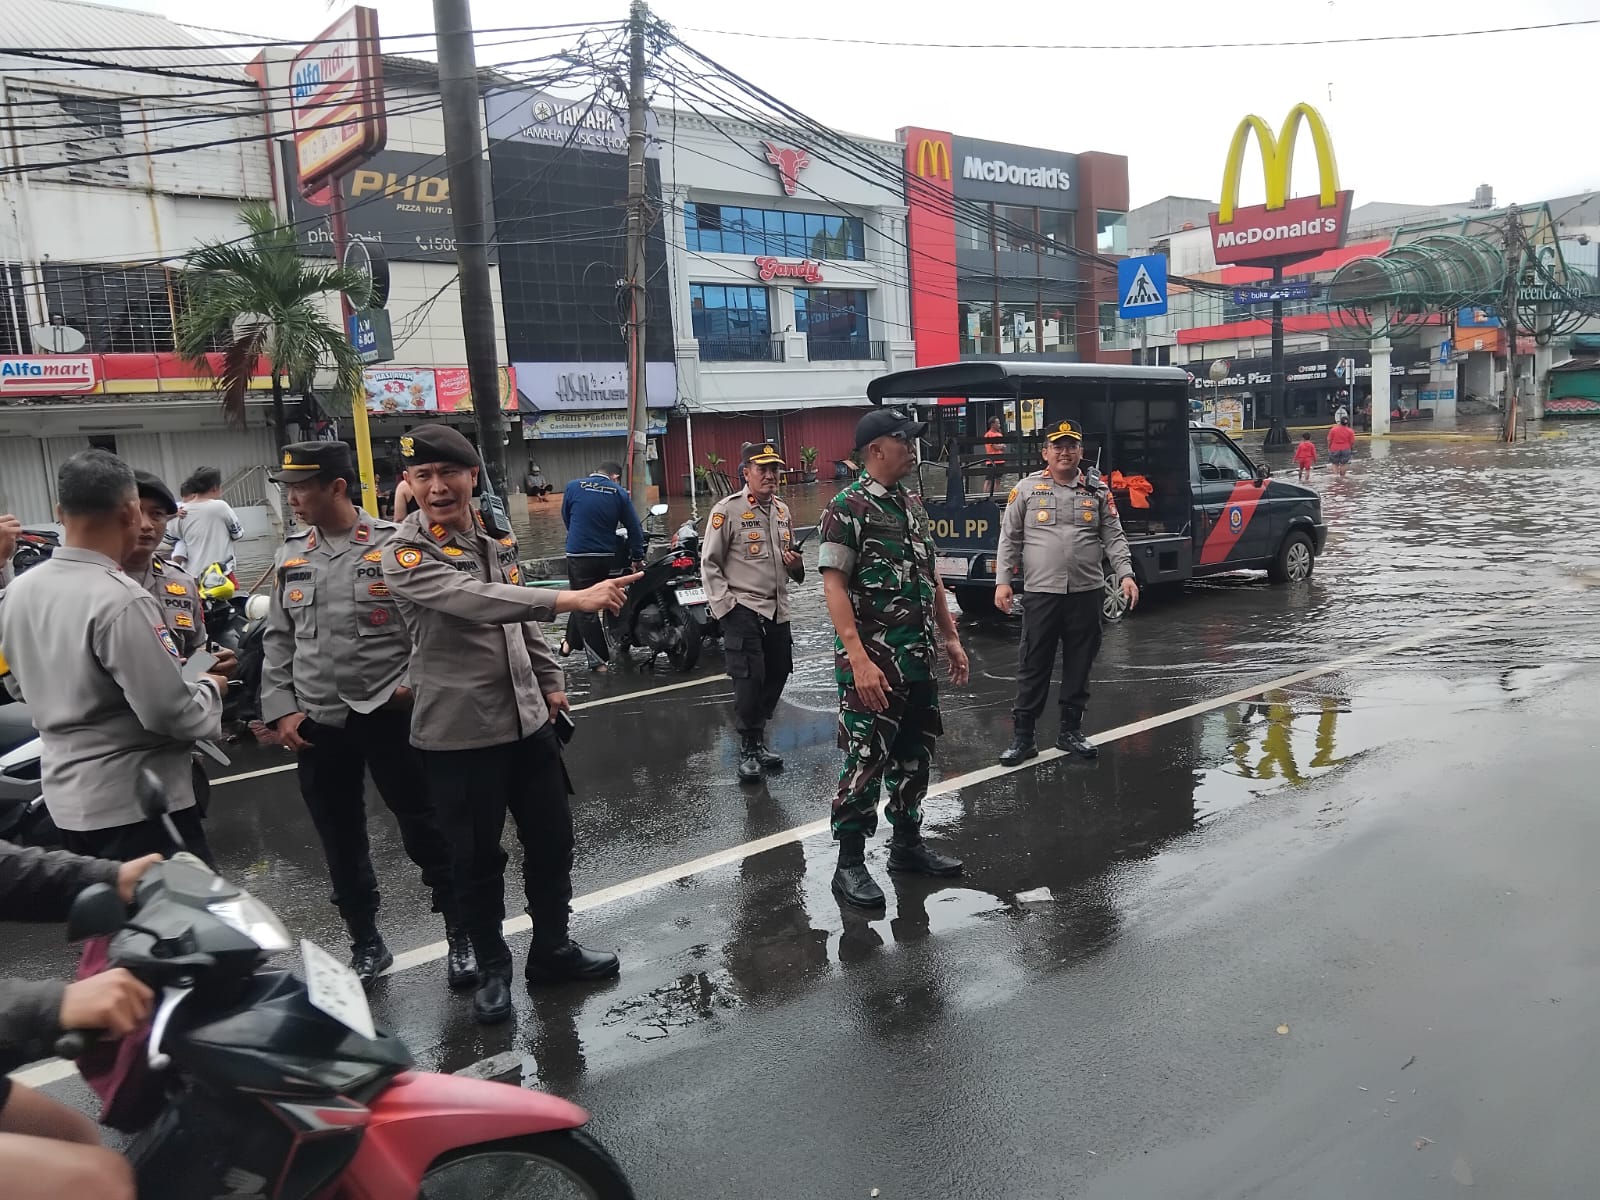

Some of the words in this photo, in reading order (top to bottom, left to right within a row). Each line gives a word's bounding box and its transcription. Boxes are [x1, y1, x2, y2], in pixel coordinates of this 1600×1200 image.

[553, 103, 617, 132] YAMAHA
[520, 125, 564, 141] YAMAHA
[596, 135, 630, 149] SCHOO
[963, 156, 1070, 190] McDonald's
[396, 203, 421, 213] PIZZA
[425, 206, 444, 214] HUT
[1216, 217, 1336, 249] McDonald's
[756, 257, 824, 283] Gandy
[2, 362, 89, 376] Alfamart
[1248, 372, 1272, 385] Pizz
[965, 519, 988, 538] PP
